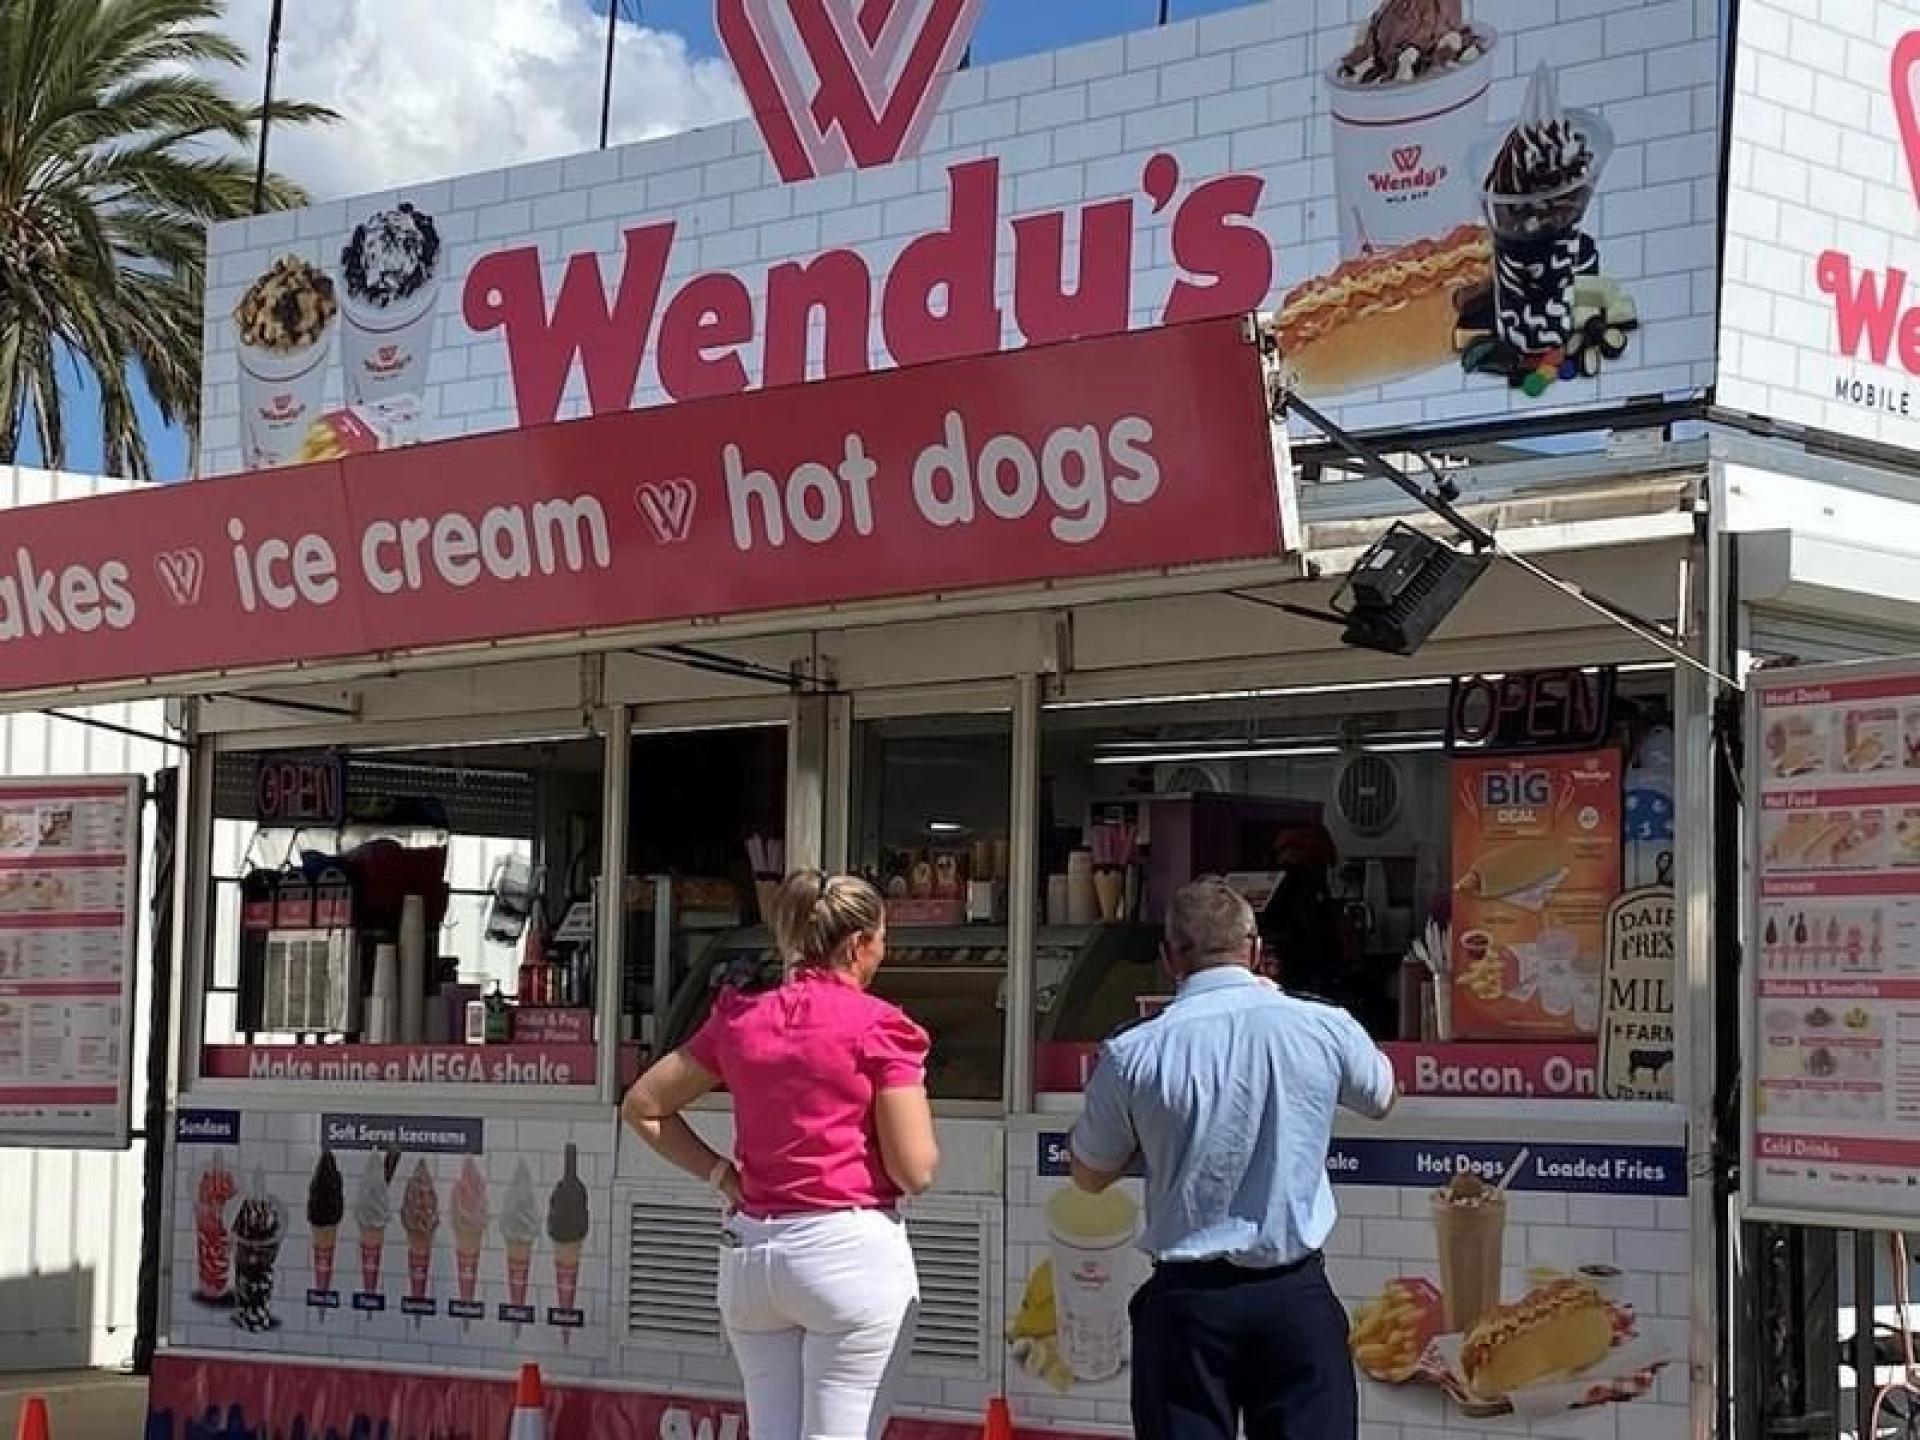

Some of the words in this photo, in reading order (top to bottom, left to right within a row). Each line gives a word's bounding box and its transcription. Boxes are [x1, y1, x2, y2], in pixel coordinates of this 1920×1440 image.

[1835, 376, 1909, 416] MOBILE
[228, 518, 339, 614] ice
[361, 494, 611, 595] cream
[724, 433, 878, 552] hot
[911, 410, 1161, 544] dogs
[1454, 673, 1600, 740] OPEN
[259, 765, 339, 817] OPEN
[1483, 769, 1550, 807] BIG
[249, 1053, 313, 1079] Make
[318, 1053, 380, 1080] mine
[407, 1053, 485, 1083] MEGA
[493, 1053, 571, 1084] shake
[1415, 1055, 1535, 1096] Bacon,
[1543, 1055, 1595, 1093] On
[179, 1117, 231, 1136] Sundaes
[328, 1121, 356, 1142] Soft
[359, 1122, 397, 1144] Serve
[399, 1126, 467, 1146] Icecreams
[1416, 1152, 1451, 1173] Hot
[1456, 1153, 1503, 1179] Dogs
[1535, 1156, 1609, 1178] Loaded
[1614, 1159, 1665, 1181] Fries
